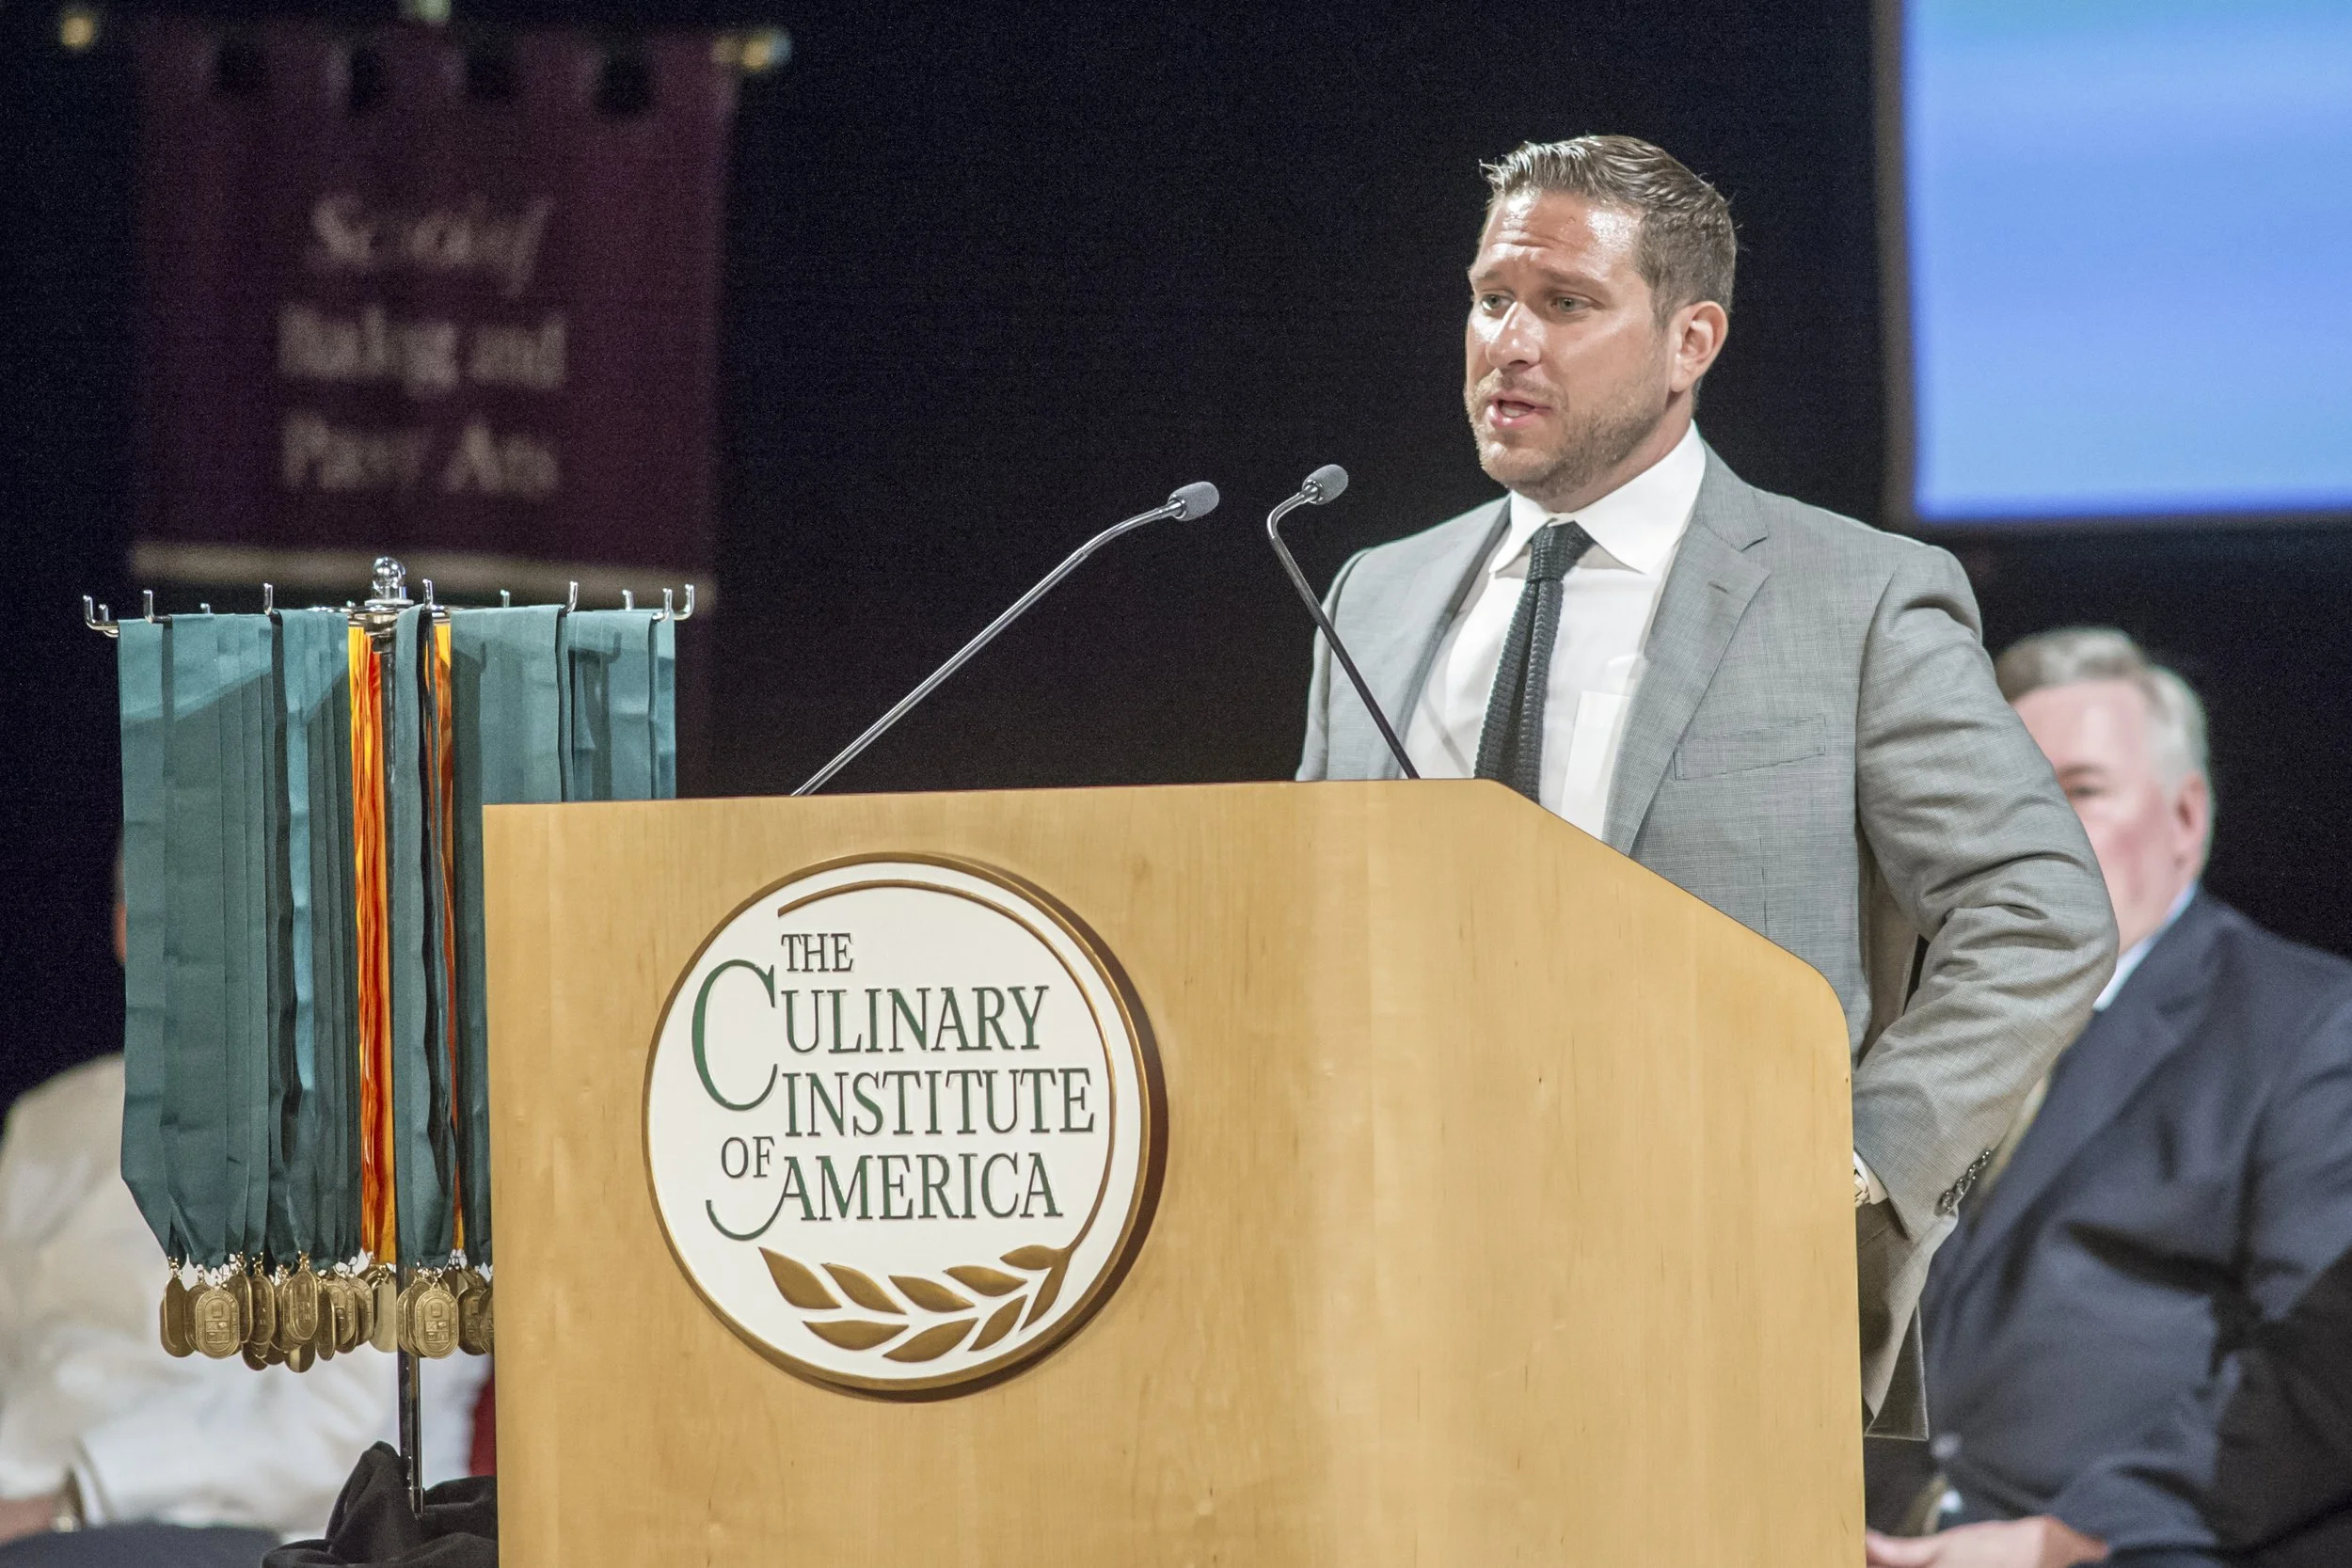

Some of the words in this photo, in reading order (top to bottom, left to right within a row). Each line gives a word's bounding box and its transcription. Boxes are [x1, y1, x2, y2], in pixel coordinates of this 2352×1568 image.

[781, 932, 853, 973] THE
[691, 958, 1050, 1112] CULINARY
[782, 1068, 1095, 1137] INSTITUTE
[721, 1135, 775, 1180] OF
[705, 1152, 1064, 1242] AMERICA
